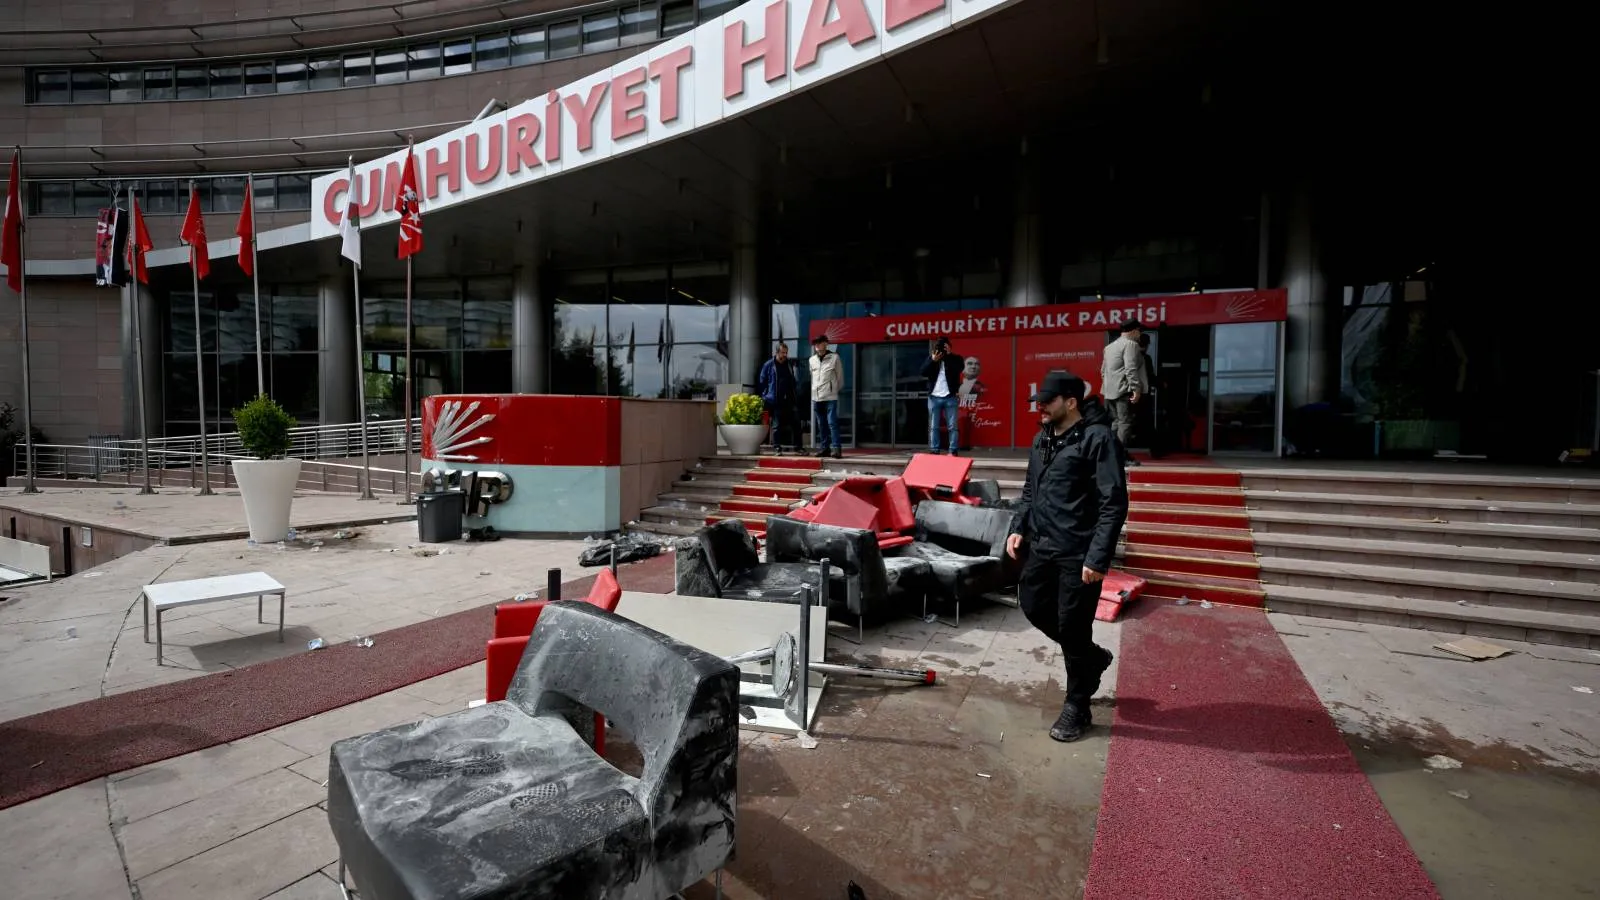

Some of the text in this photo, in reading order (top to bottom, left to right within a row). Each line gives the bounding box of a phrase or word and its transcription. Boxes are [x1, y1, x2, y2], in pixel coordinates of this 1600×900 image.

[886, 302, 1167, 337] CUMHURİYET HALK PARTİSİ
